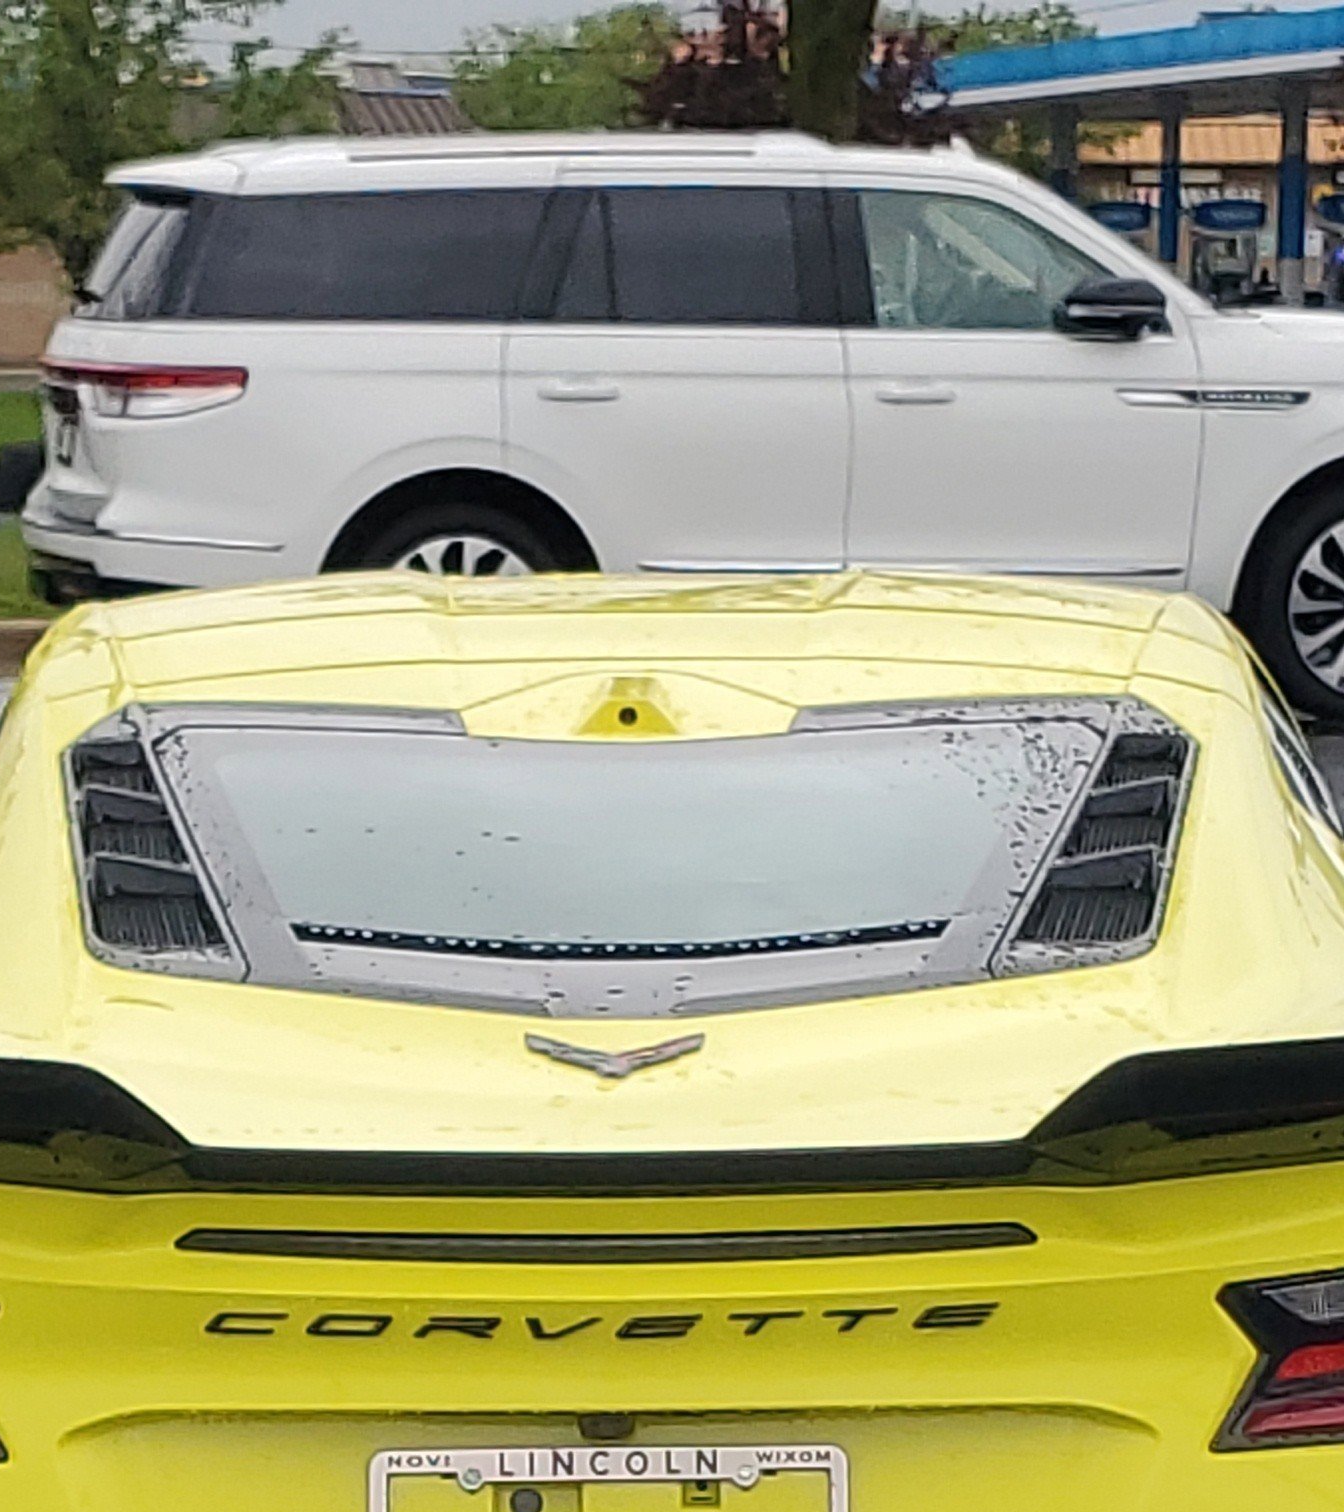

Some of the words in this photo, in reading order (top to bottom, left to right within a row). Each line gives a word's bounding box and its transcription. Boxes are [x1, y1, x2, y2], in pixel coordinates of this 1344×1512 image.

[203, 1301, 1000, 1339] CORVETTE
[387, 1454, 451, 1468] NOVI
[498, 1449, 718, 1477] LINCOLN
[755, 1450, 831, 1463] WIXOM
